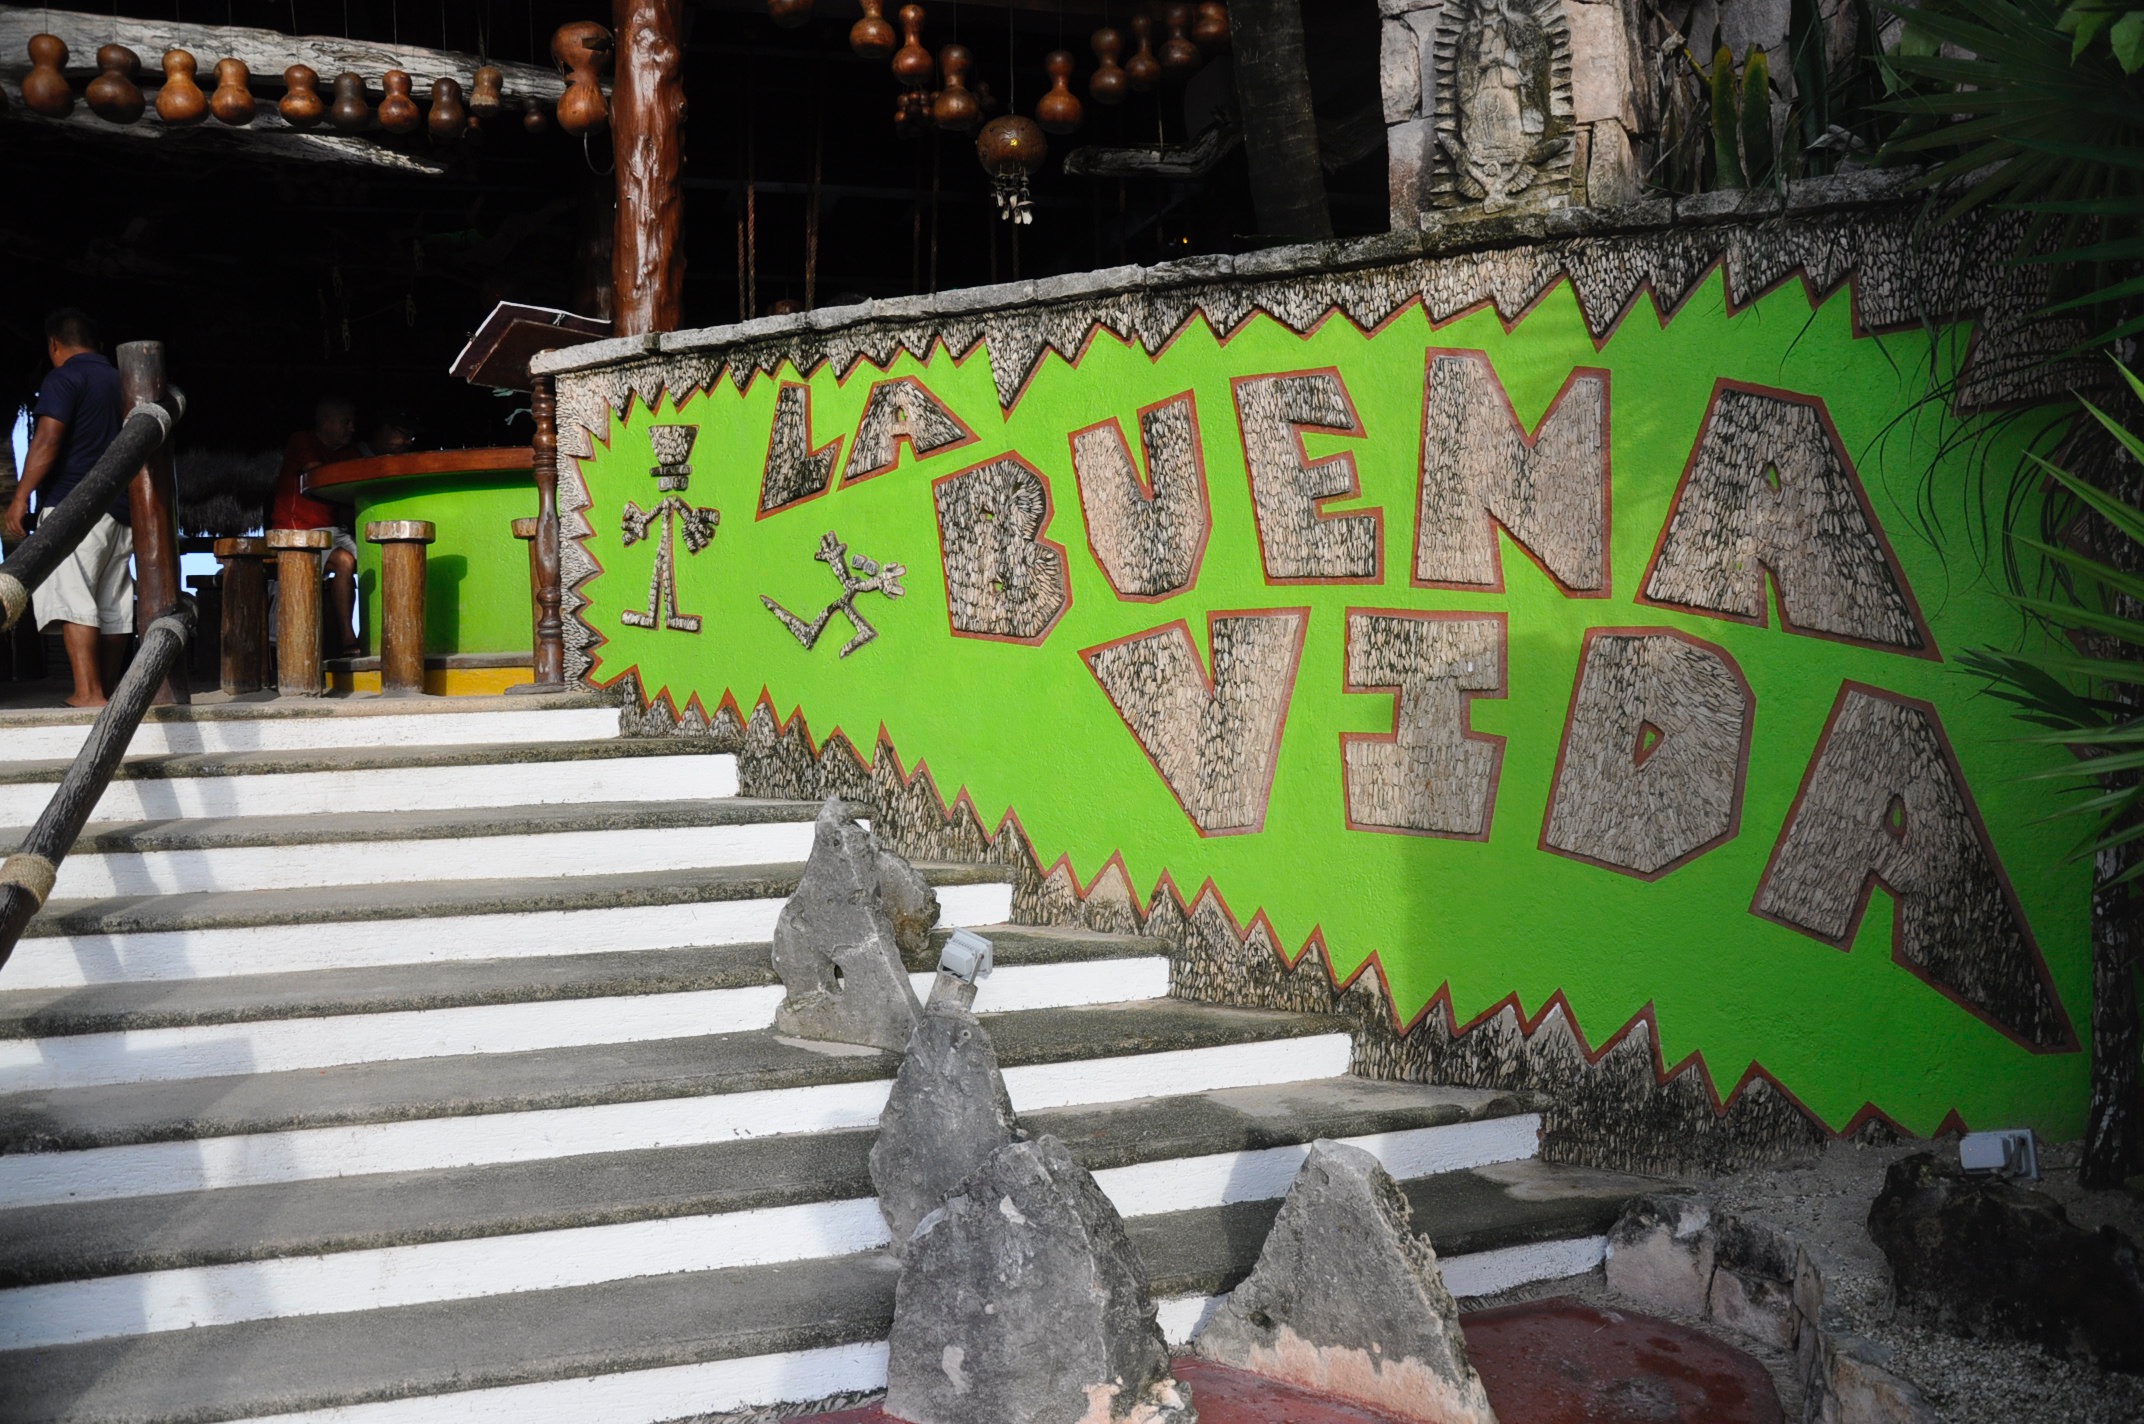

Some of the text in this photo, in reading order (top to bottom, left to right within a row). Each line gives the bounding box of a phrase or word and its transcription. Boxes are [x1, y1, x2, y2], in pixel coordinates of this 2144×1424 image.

[755, 375, 981, 521] LA
[932, 346, 1944, 662] BUENA
[1078, 606, 2082, 1056] VIDA
